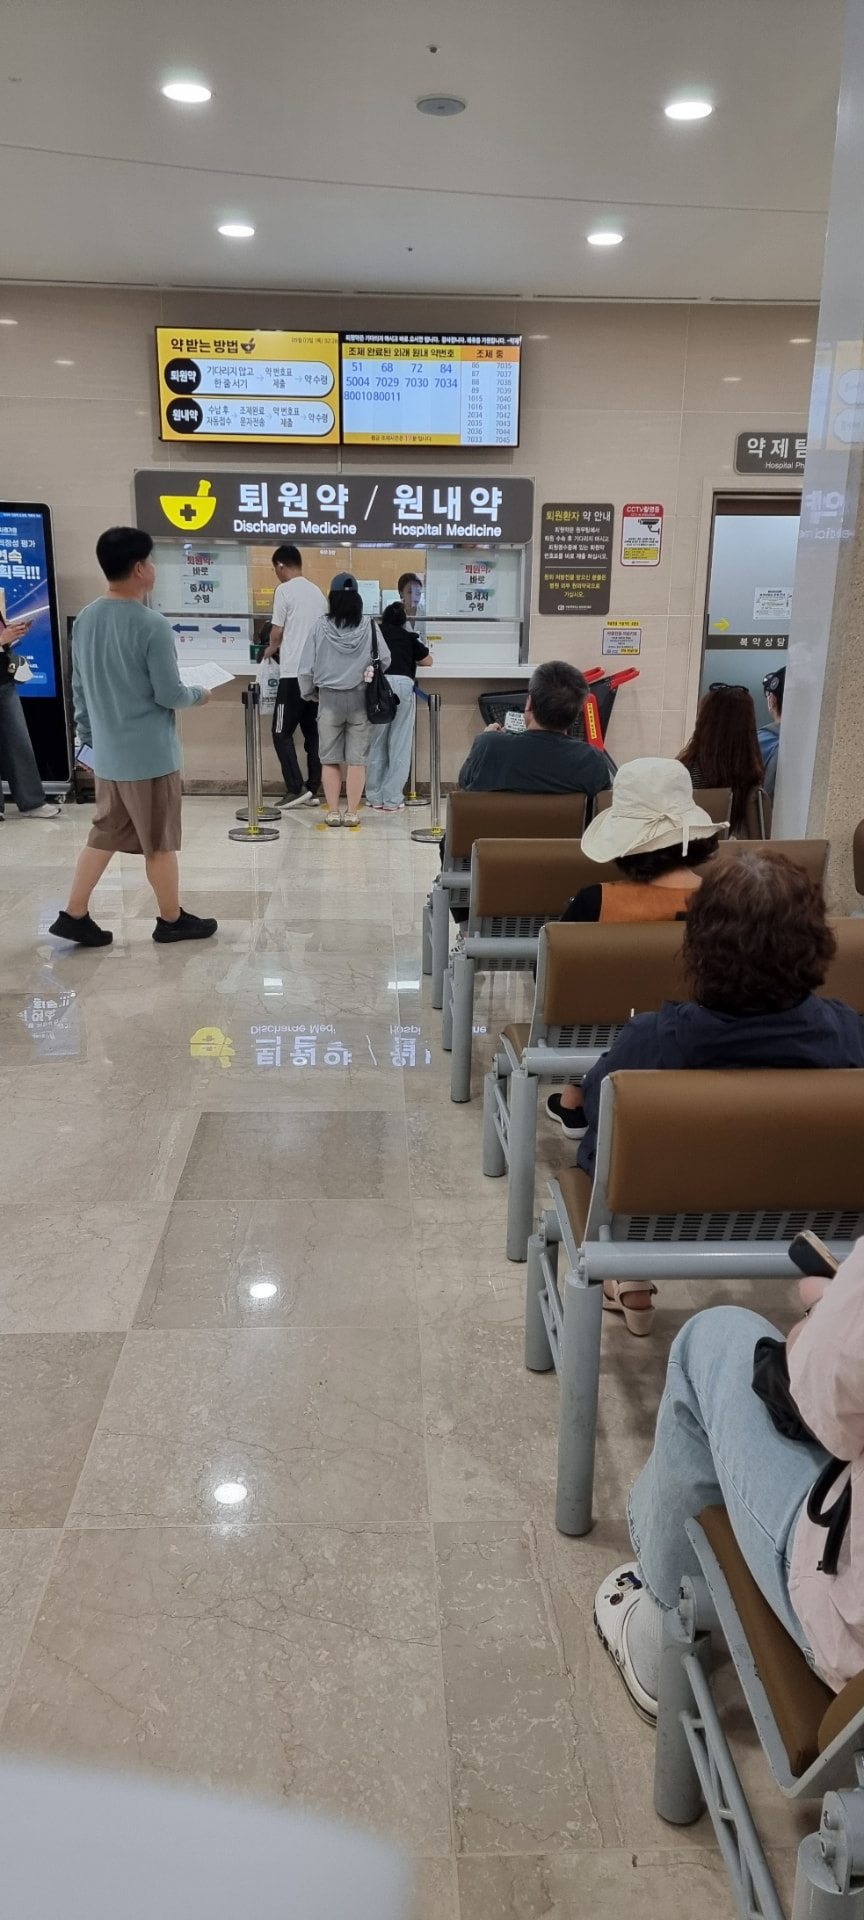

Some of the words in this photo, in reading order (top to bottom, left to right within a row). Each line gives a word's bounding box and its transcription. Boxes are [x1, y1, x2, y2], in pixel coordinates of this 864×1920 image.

[171, 338, 183, 352] 약
[186, 339, 211, 353] 받는
[214, 340, 239, 354] 방법
[349, 346, 365, 356] 조제
[367, 347, 391, 357] 완료된
[394, 348, 410, 357] 외래
[413, 348, 428, 357] 원내
[431, 349, 454, 358] 약번호
[477, 350, 493, 358] 조제
[496, 350, 504, 358] 중
[207, 366, 238, 376] 기다리지
[239, 367, 254, 376] 않고
[265, 367, 272, 376] 약
[273, 367, 292, 376] 번호표
[352, 362, 362, 372] 51
[381, 362, 393, 372] 68
[410, 363, 423, 373] 72
[440, 364, 452, 373] 84
[170, 370, 196, 383] 퇴원약
[304, 375, 313, 384] 약
[314, 375, 328, 384] 수령
[214, 379, 222, 388] 한
[224, 379, 231, 388] 줄
[232, 379, 248, 388] 서기
[273, 379, 286, 388] 제출
[346, 376, 370, 386] 5004
[376, 377, 399, 387] 7029
[405, 378, 428, 387] 7030
[434, 378, 457, 388] 7034
[344, 391, 372, 400] 80010
[373, 392, 400, 401] 80011
[208, 405, 221, 414] 수납
[222, 405, 229, 414] 후
[239, 406, 265, 415] 조제완료
[273, 406, 281, 415] 약
[282, 407, 299, 415] 번호표
[172, 409, 199, 422] 원내약
[308, 413, 315, 422] 약
[315, 413, 328, 422] 수령
[206, 417, 232, 426] 자동접수
[240, 418, 265, 426] 문자전송
[280, 418, 293, 428] 제출
[238, 482, 349, 519] 퇴원약
[364, 485, 378, 521] /
[393, 484, 502, 522] 원내약
[546, 510, 579, 522] 퇴원환자
[582, 511, 592, 521] 약
[594, 511, 611, 522] 안내
[233, 519, 297, 535] Discharge
[300, 520, 357, 535] Medicine
[392, 522, 444, 538] Hospital
[446, 523, 502, 537] Medicine
[21, 540, 36, 548] 평가
[193, 567, 209, 576] 바로
[470, 576, 485, 584] 바로
[190, 584, 213, 592] 줄서서
[194, 594, 210, 603] 수령
[465, 592, 488, 601] 줄서서
[469, 602, 484, 612] 수령
[740, 638, 785, 647] 복약상담
